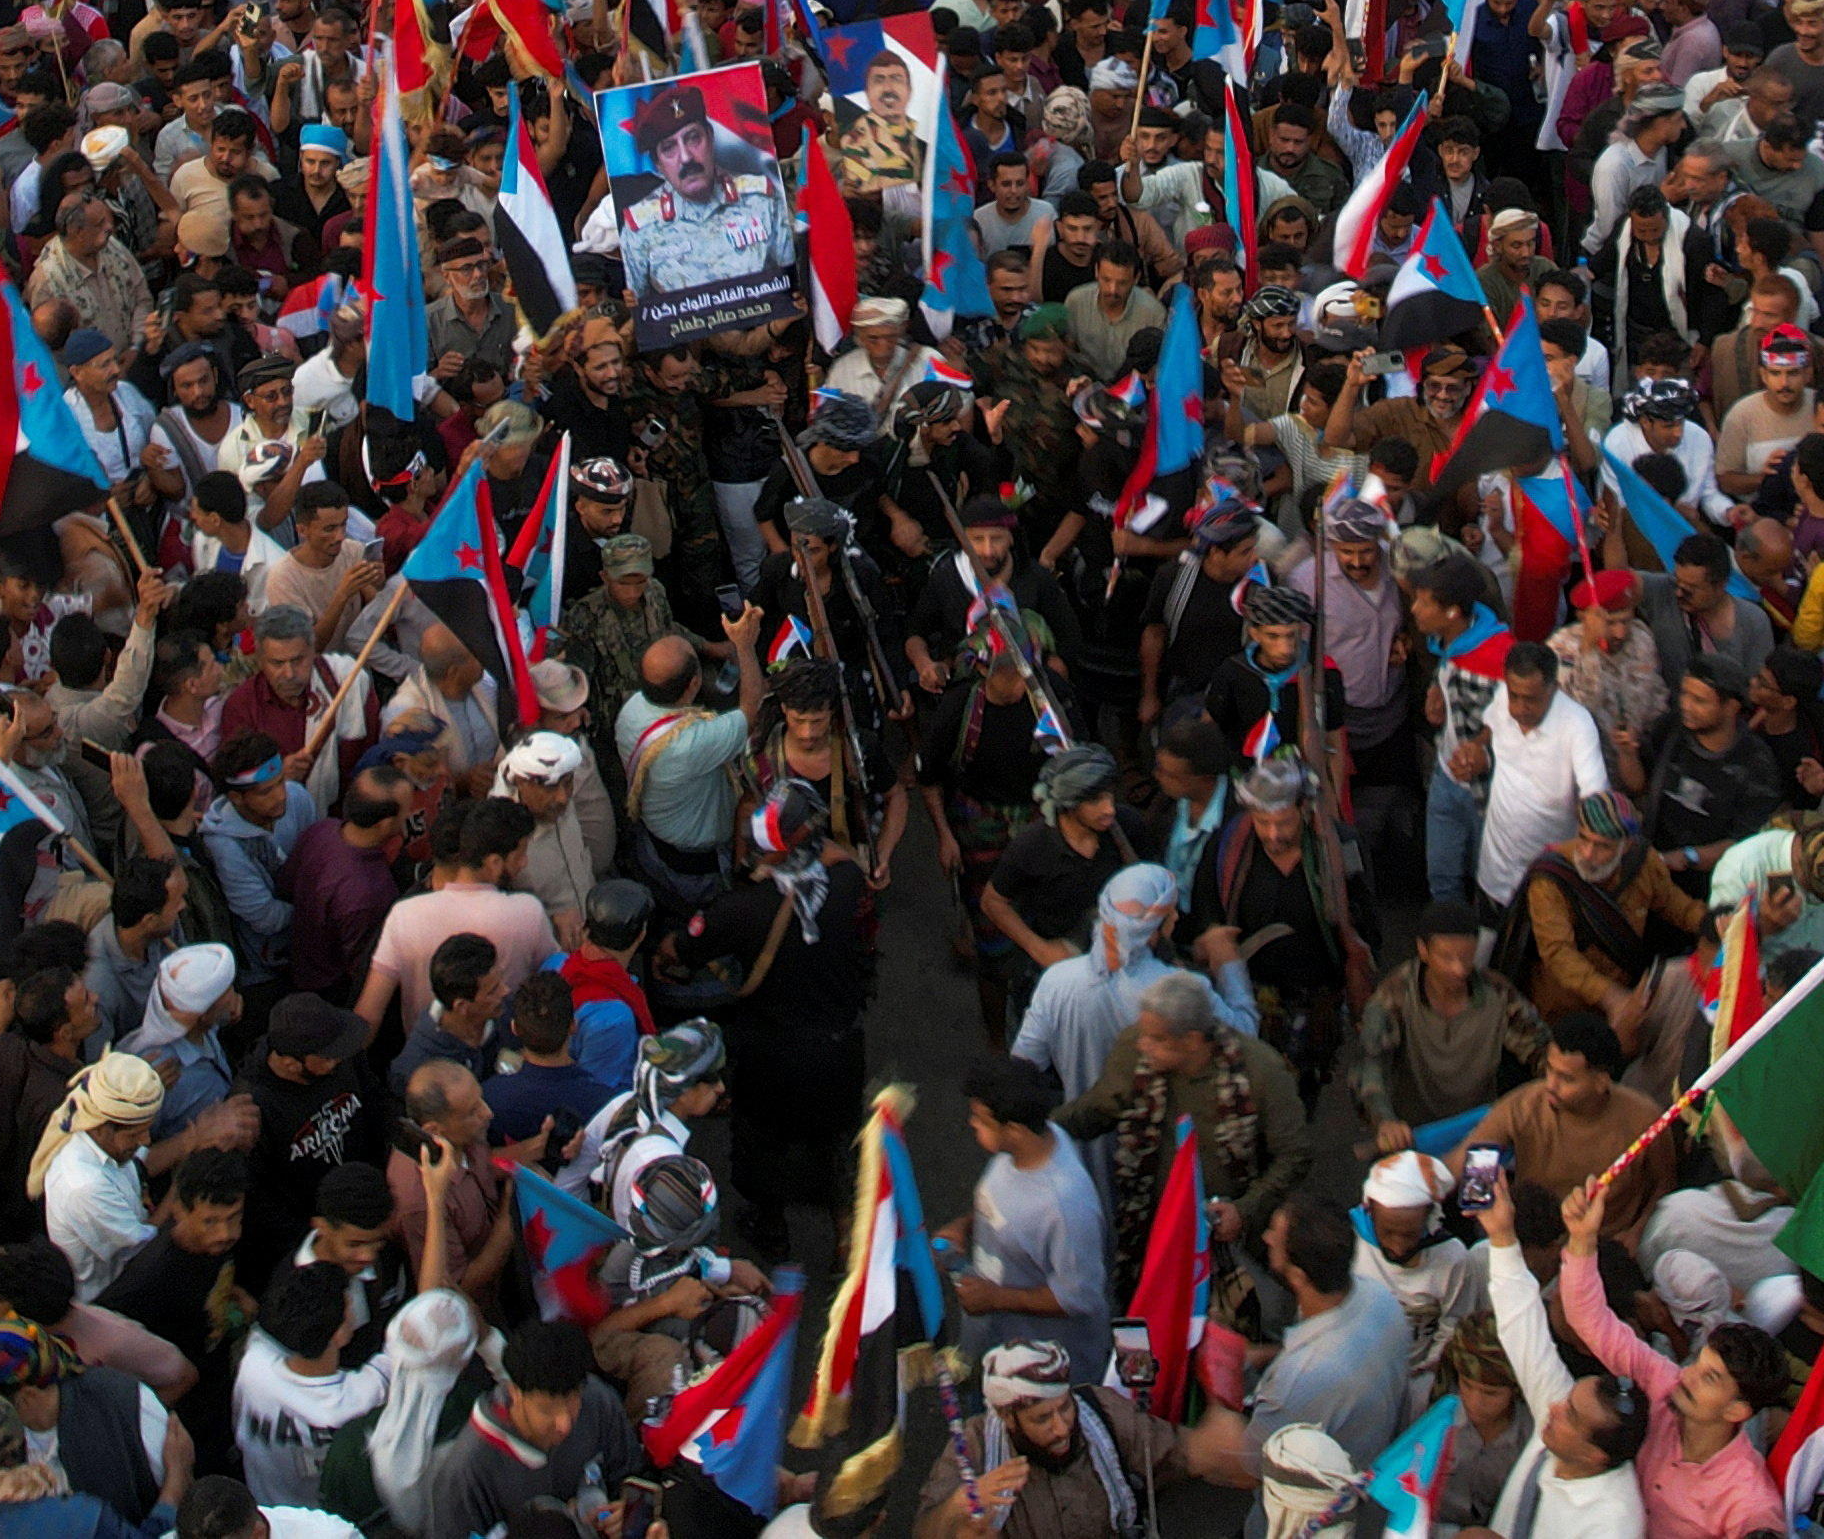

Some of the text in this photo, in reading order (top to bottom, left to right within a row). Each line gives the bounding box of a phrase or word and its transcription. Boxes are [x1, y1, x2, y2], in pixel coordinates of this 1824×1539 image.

[711, 285, 746, 306] القائد
[746, 274, 791, 298] الشهيد
[650, 302, 676, 321] ركن
[679, 292, 712, 313] اللواء
[738, 302, 772, 316] محمد
[706, 307, 737, 330] صالح
